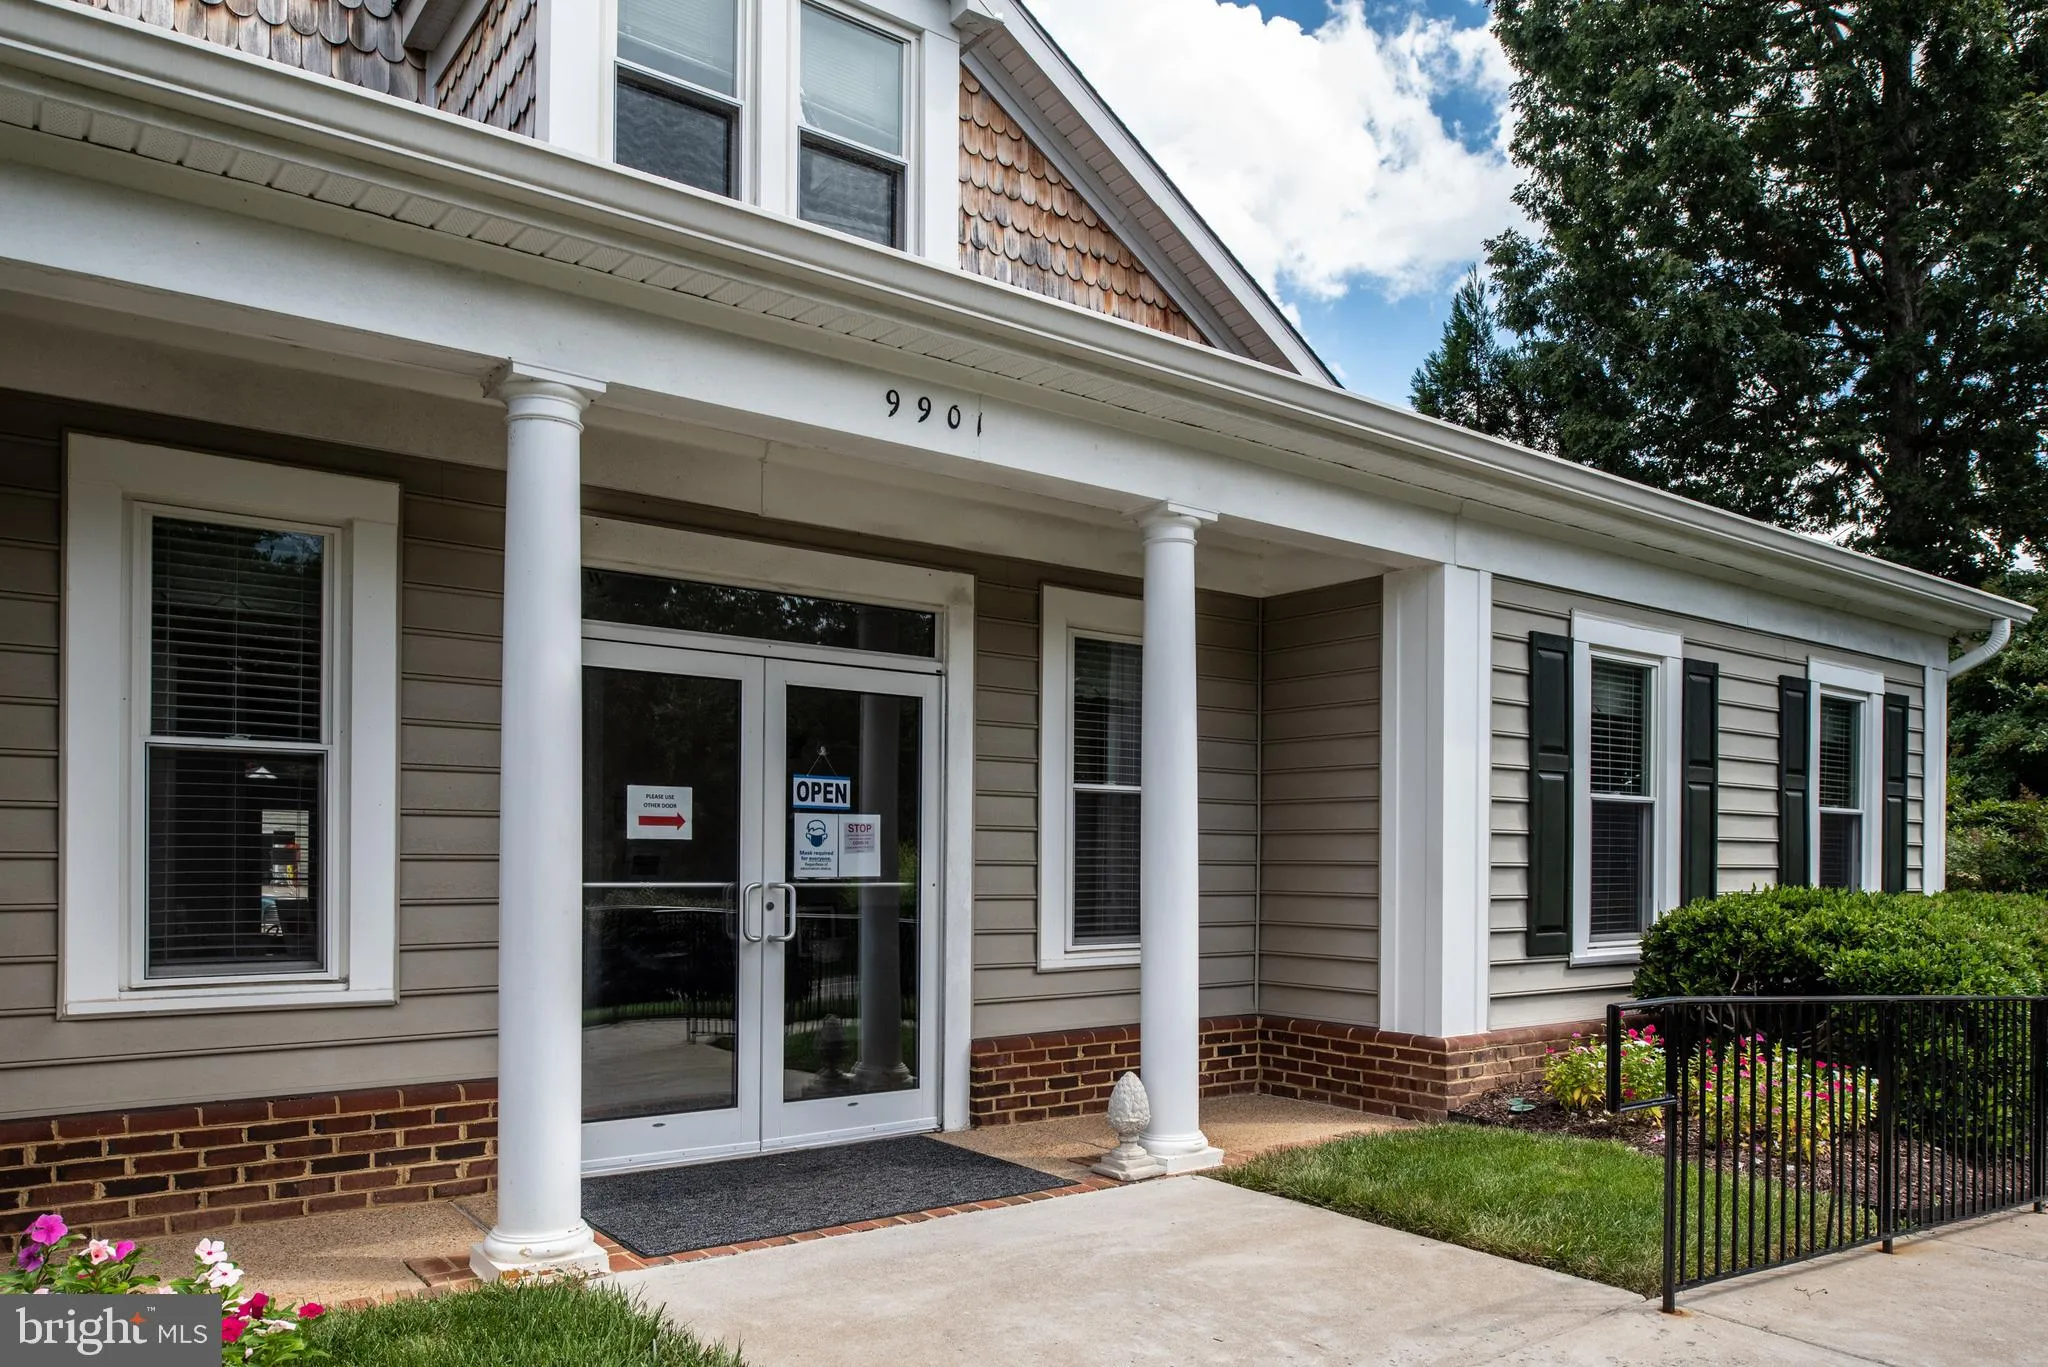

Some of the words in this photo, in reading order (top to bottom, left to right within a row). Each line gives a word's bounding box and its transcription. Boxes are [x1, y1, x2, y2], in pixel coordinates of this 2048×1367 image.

[886, 390, 983, 437] 9901
[797, 781, 847, 804] OPEN
[848, 823, 872, 833] STOP
